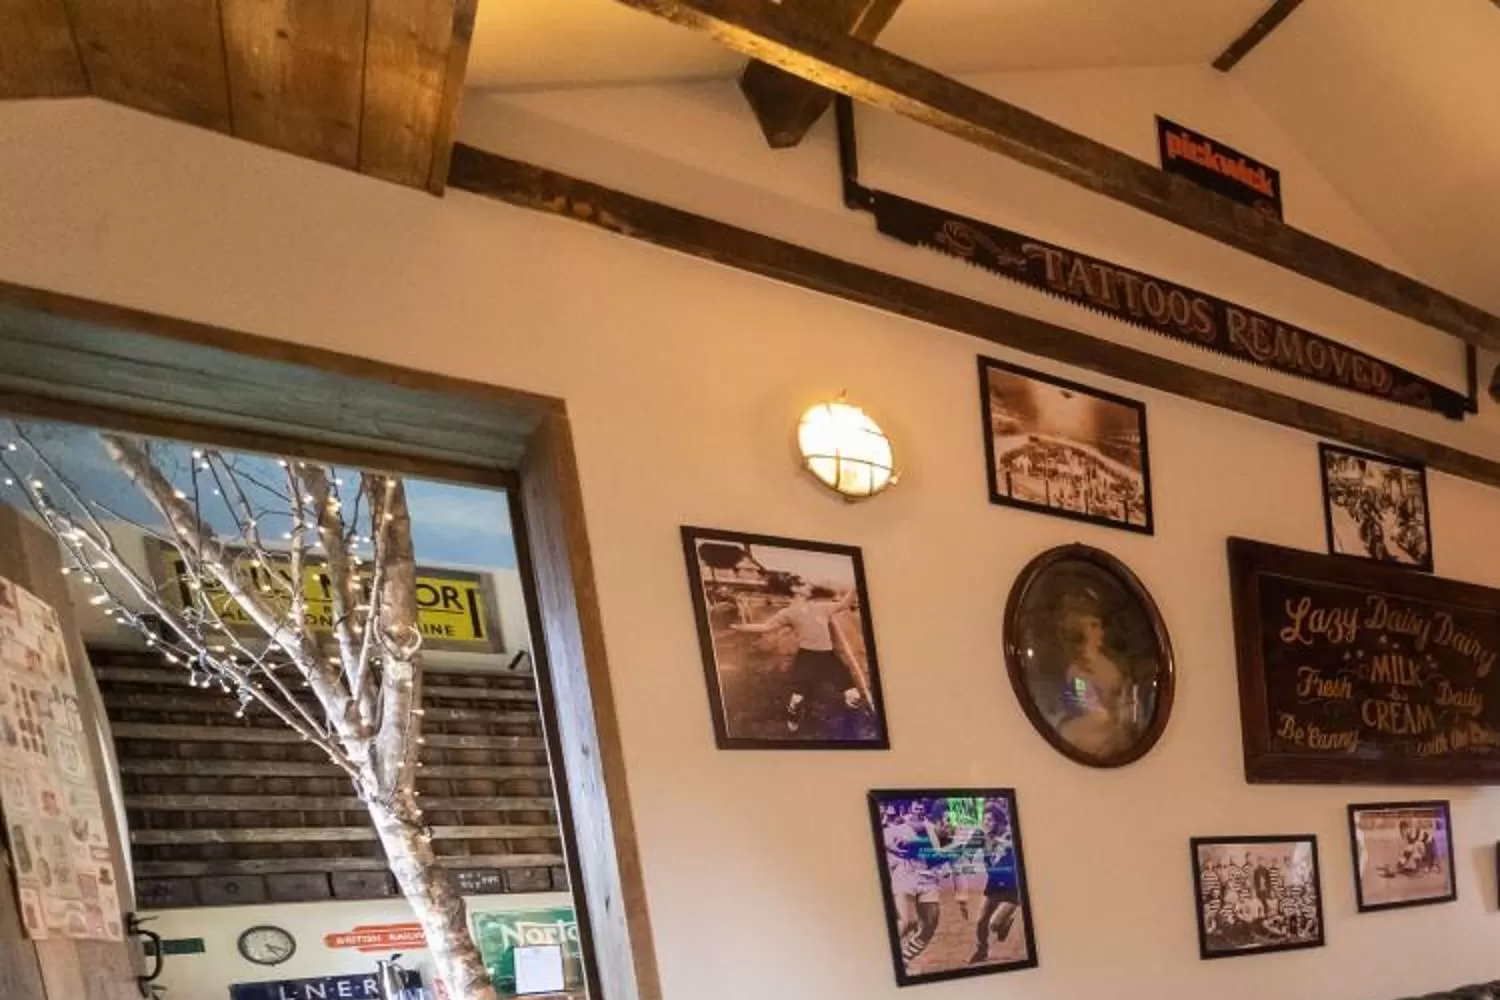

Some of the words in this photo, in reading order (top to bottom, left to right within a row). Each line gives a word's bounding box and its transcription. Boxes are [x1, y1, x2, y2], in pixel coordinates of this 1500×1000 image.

[1165, 130, 1275, 198] pickwick
[1021, 242, 1217, 342] TATTOOS
[1226, 307, 1393, 393] REMOVED
[1280, 596, 1360, 646] Lazy
[1364, 595, 1432, 651] Daisy
[1434, 611, 1498, 678] Dairy
[1297, 666, 1352, 698] Fresh
[1371, 654, 1423, 688] MILK
[1434, 681, 1483, 716] Daily
[1361, 699, 1436, 735] CREAM
[487, 917, 578, 951] Norto
